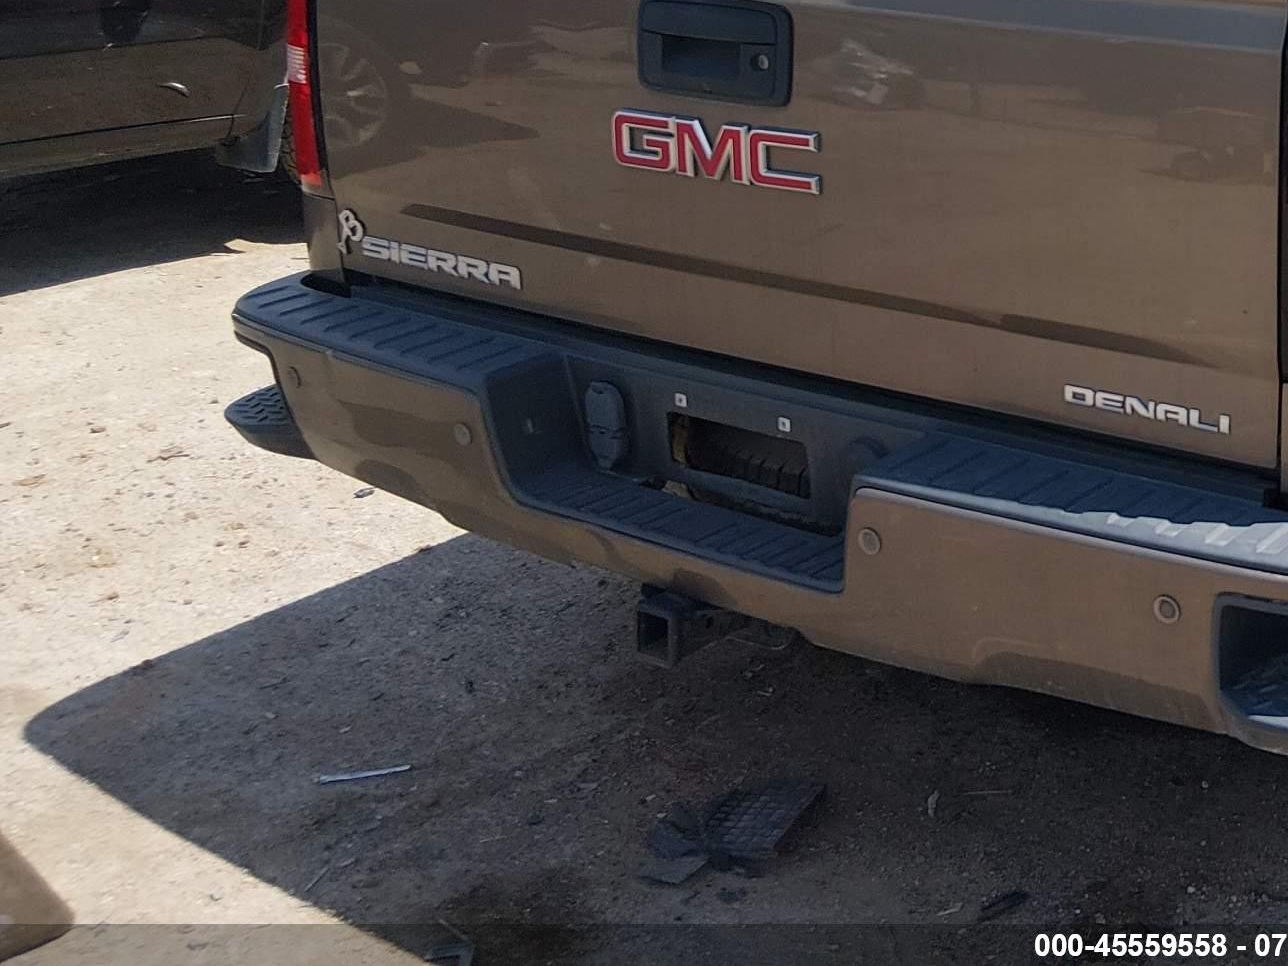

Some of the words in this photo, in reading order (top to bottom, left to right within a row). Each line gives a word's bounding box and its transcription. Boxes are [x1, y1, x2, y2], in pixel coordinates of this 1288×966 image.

[611, 107, 821, 195] GMC
[361, 235, 523, 290] SIERRA
[1063, 382, 1232, 436] DENALI
